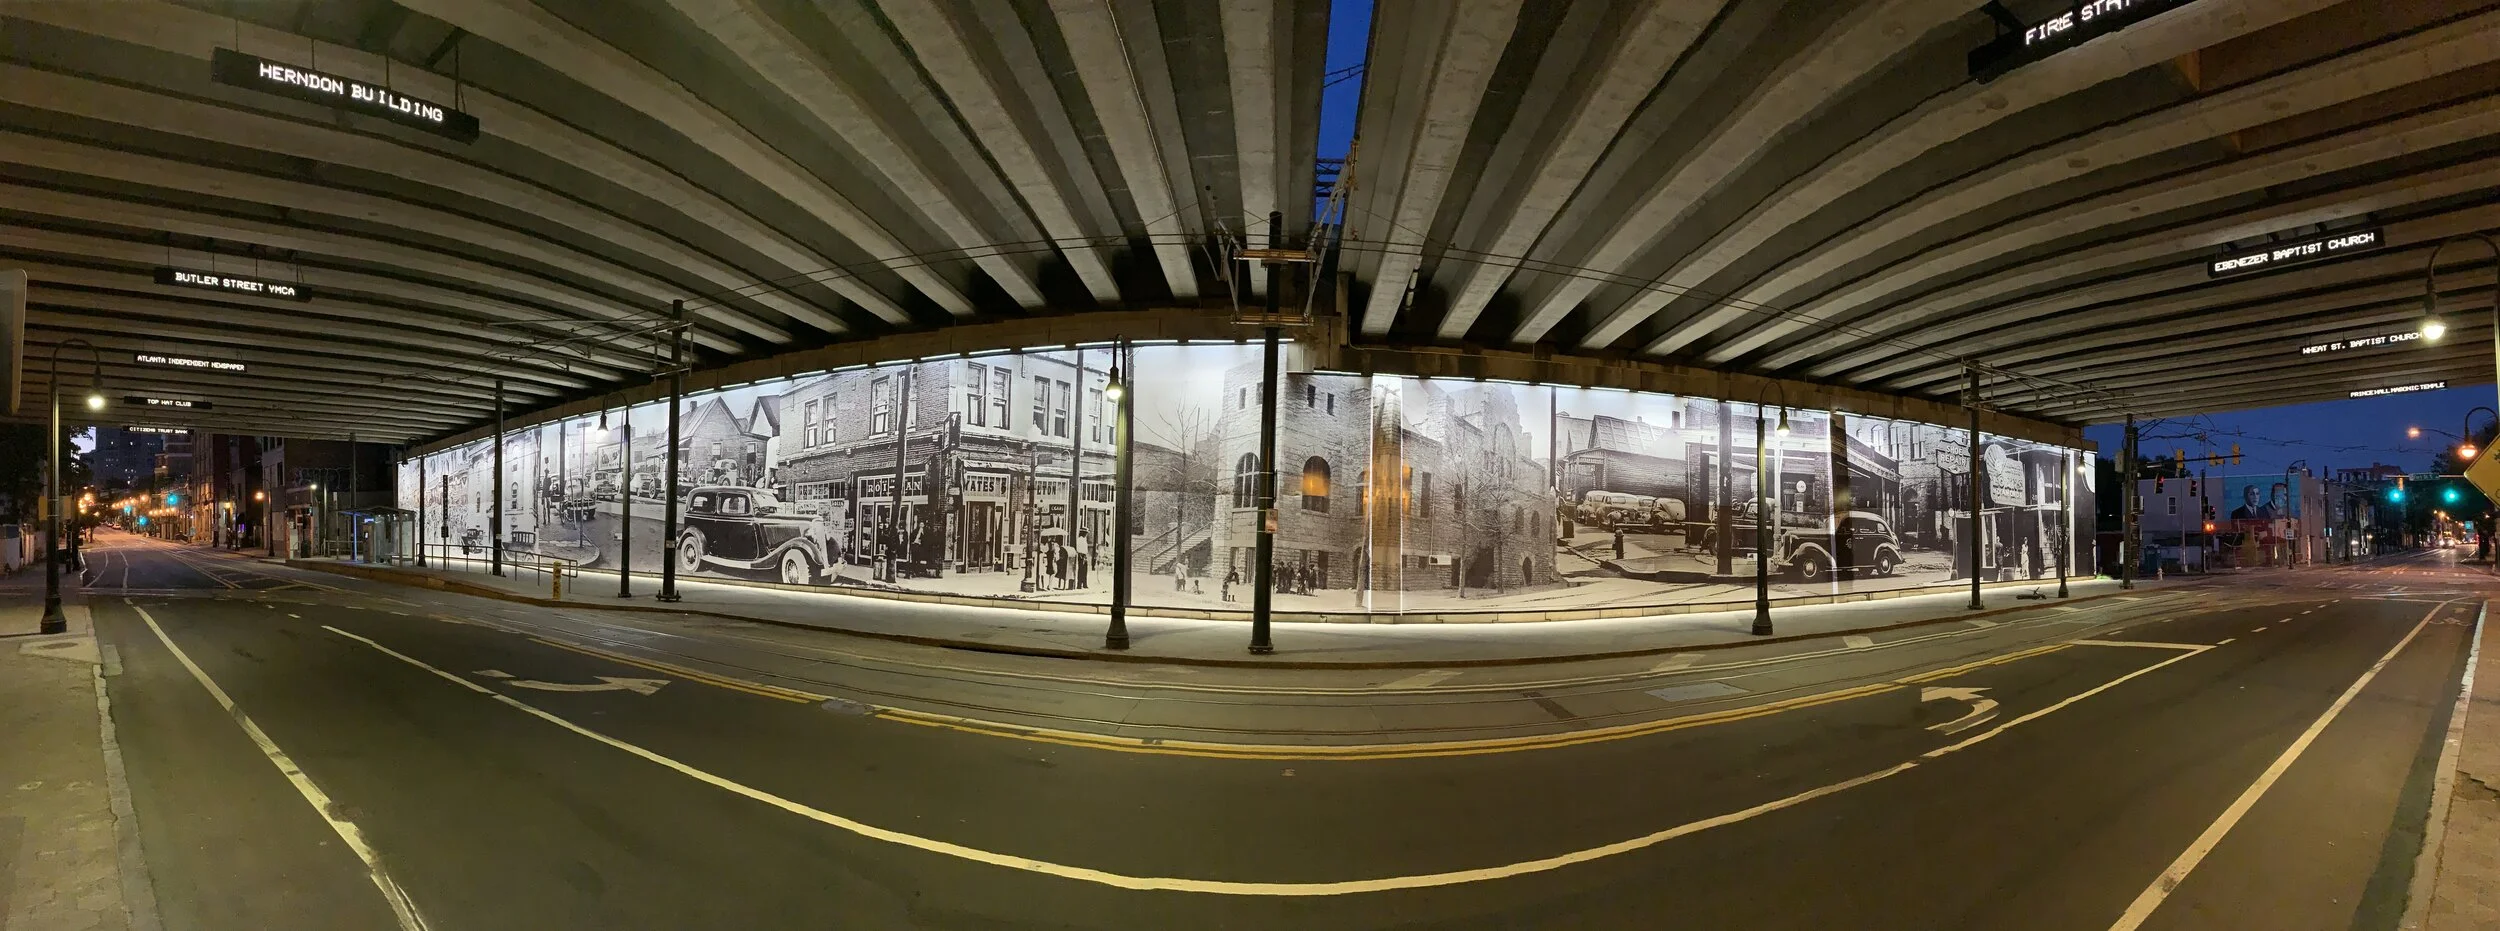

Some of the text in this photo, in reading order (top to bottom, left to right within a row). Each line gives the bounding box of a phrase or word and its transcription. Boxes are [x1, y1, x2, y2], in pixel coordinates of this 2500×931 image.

[2025, 11, 2073, 46] FIRE
[259, 62, 443, 122] HERNDON BUILDING
[2214, 232, 2375, 272] EBENEZER BAPTIST CHURCH
[175, 271, 295, 296] BUTLER STREET YMCA
[2302, 331, 2423, 355] WHEAT ST. BAPTIST CHURCH
[137, 354, 245, 371] ATLANTA INDEPENDENT NEWSPAPER
[2350, 381, 2445, 398] PRINCE HALL MASONIC TEMPLE
[1946, 446, 1963, 456] SHOE
[1940, 454, 1967, 467] REPAIR
[868, 481, 922, 493] ROI-AN
[965, 480, 995, 492] YATES
